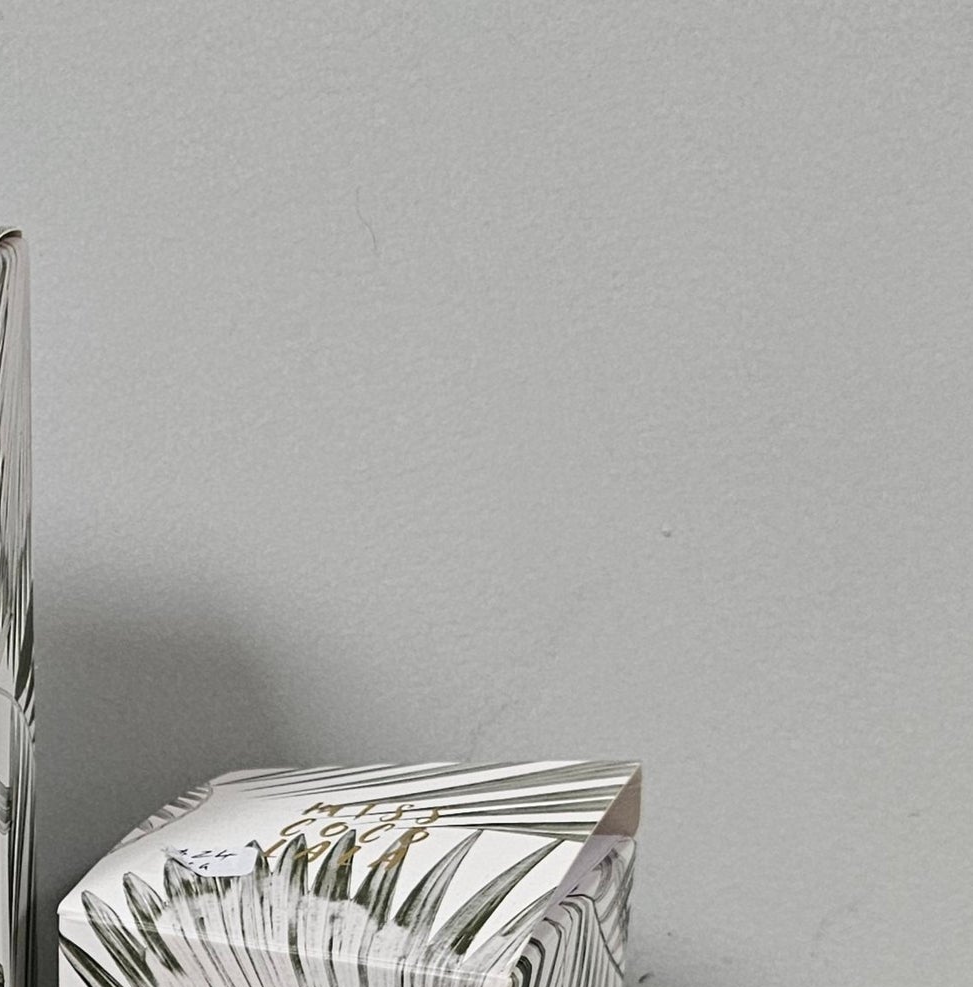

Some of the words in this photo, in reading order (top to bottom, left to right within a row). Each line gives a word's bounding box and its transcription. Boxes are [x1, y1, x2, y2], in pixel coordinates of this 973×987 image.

[302, 801, 441, 825] MISS
[280, 817, 429, 844] COCO
[263, 839, 403, 871] LALA
